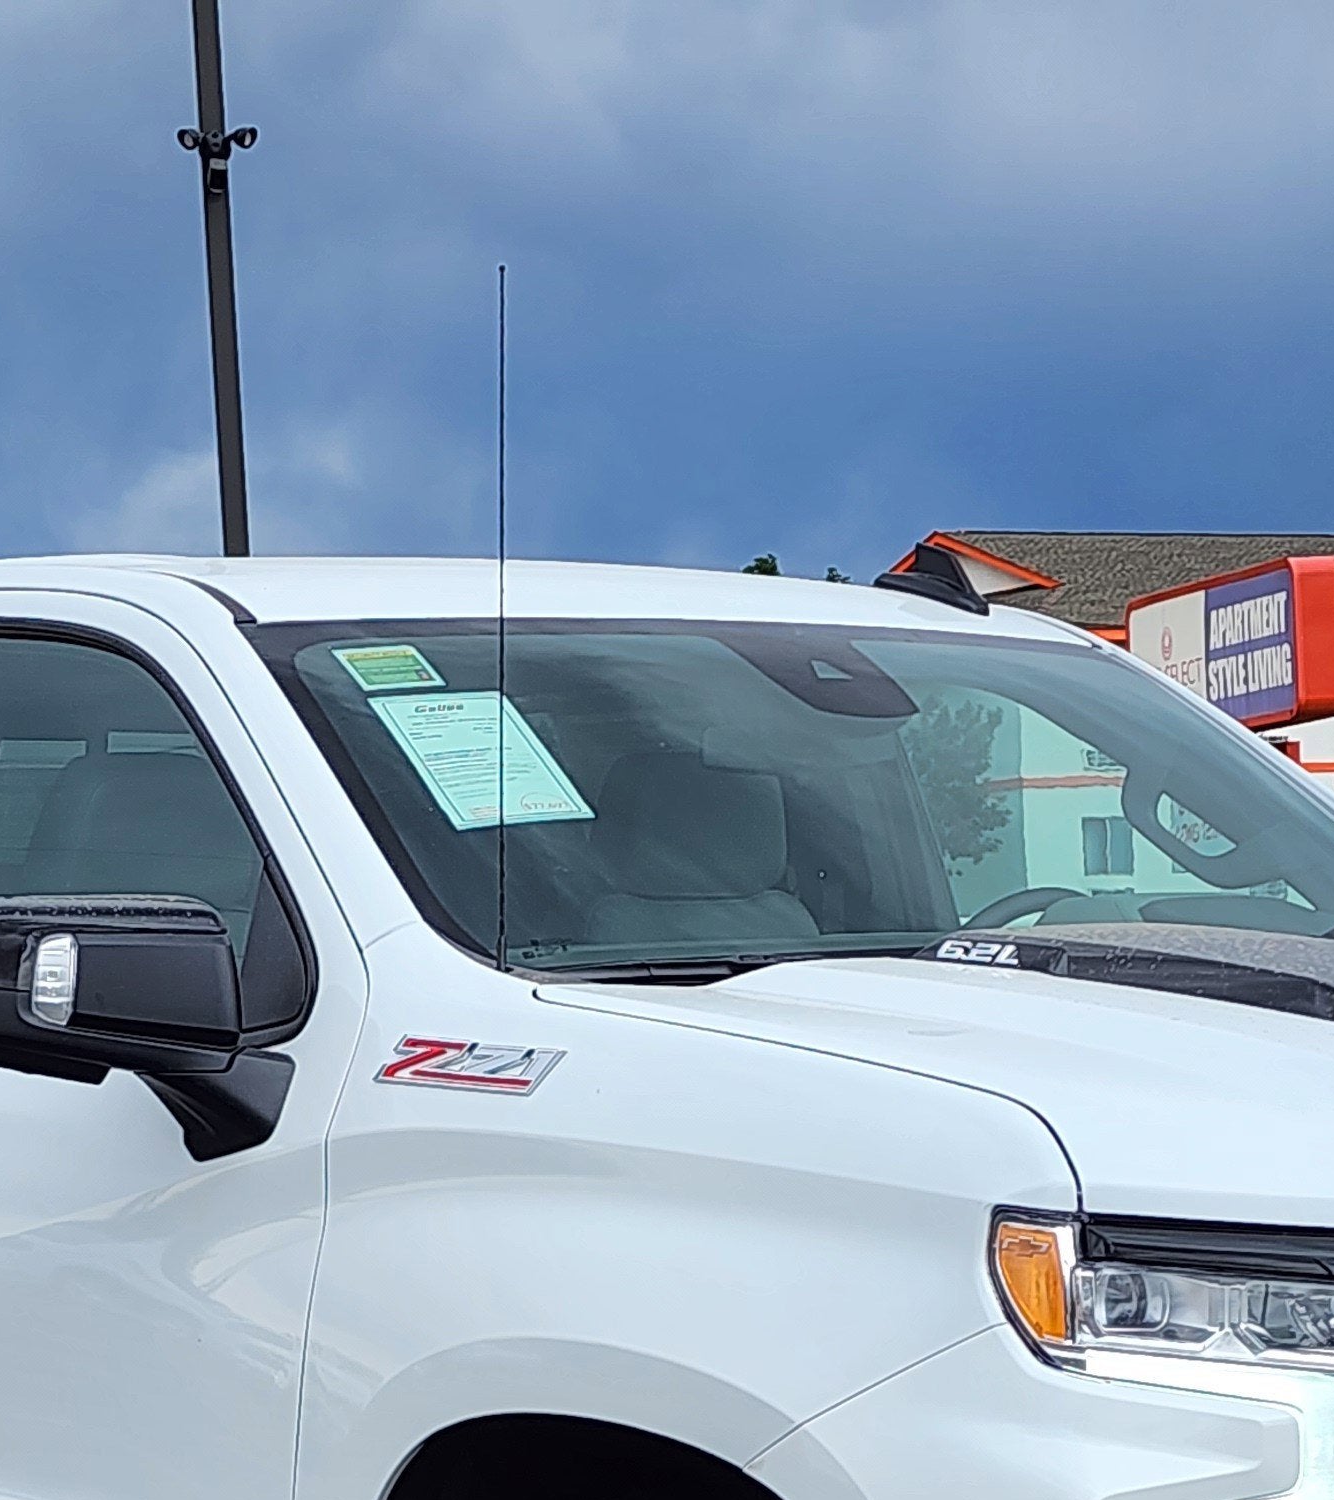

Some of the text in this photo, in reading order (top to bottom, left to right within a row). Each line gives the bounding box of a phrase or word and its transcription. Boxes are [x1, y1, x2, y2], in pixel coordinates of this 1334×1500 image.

[1209, 590, 1288, 652] APARTMENT
[1208, 642, 1293, 701] STYLE LIVING
[372, 1034, 567, 1098] Z71
